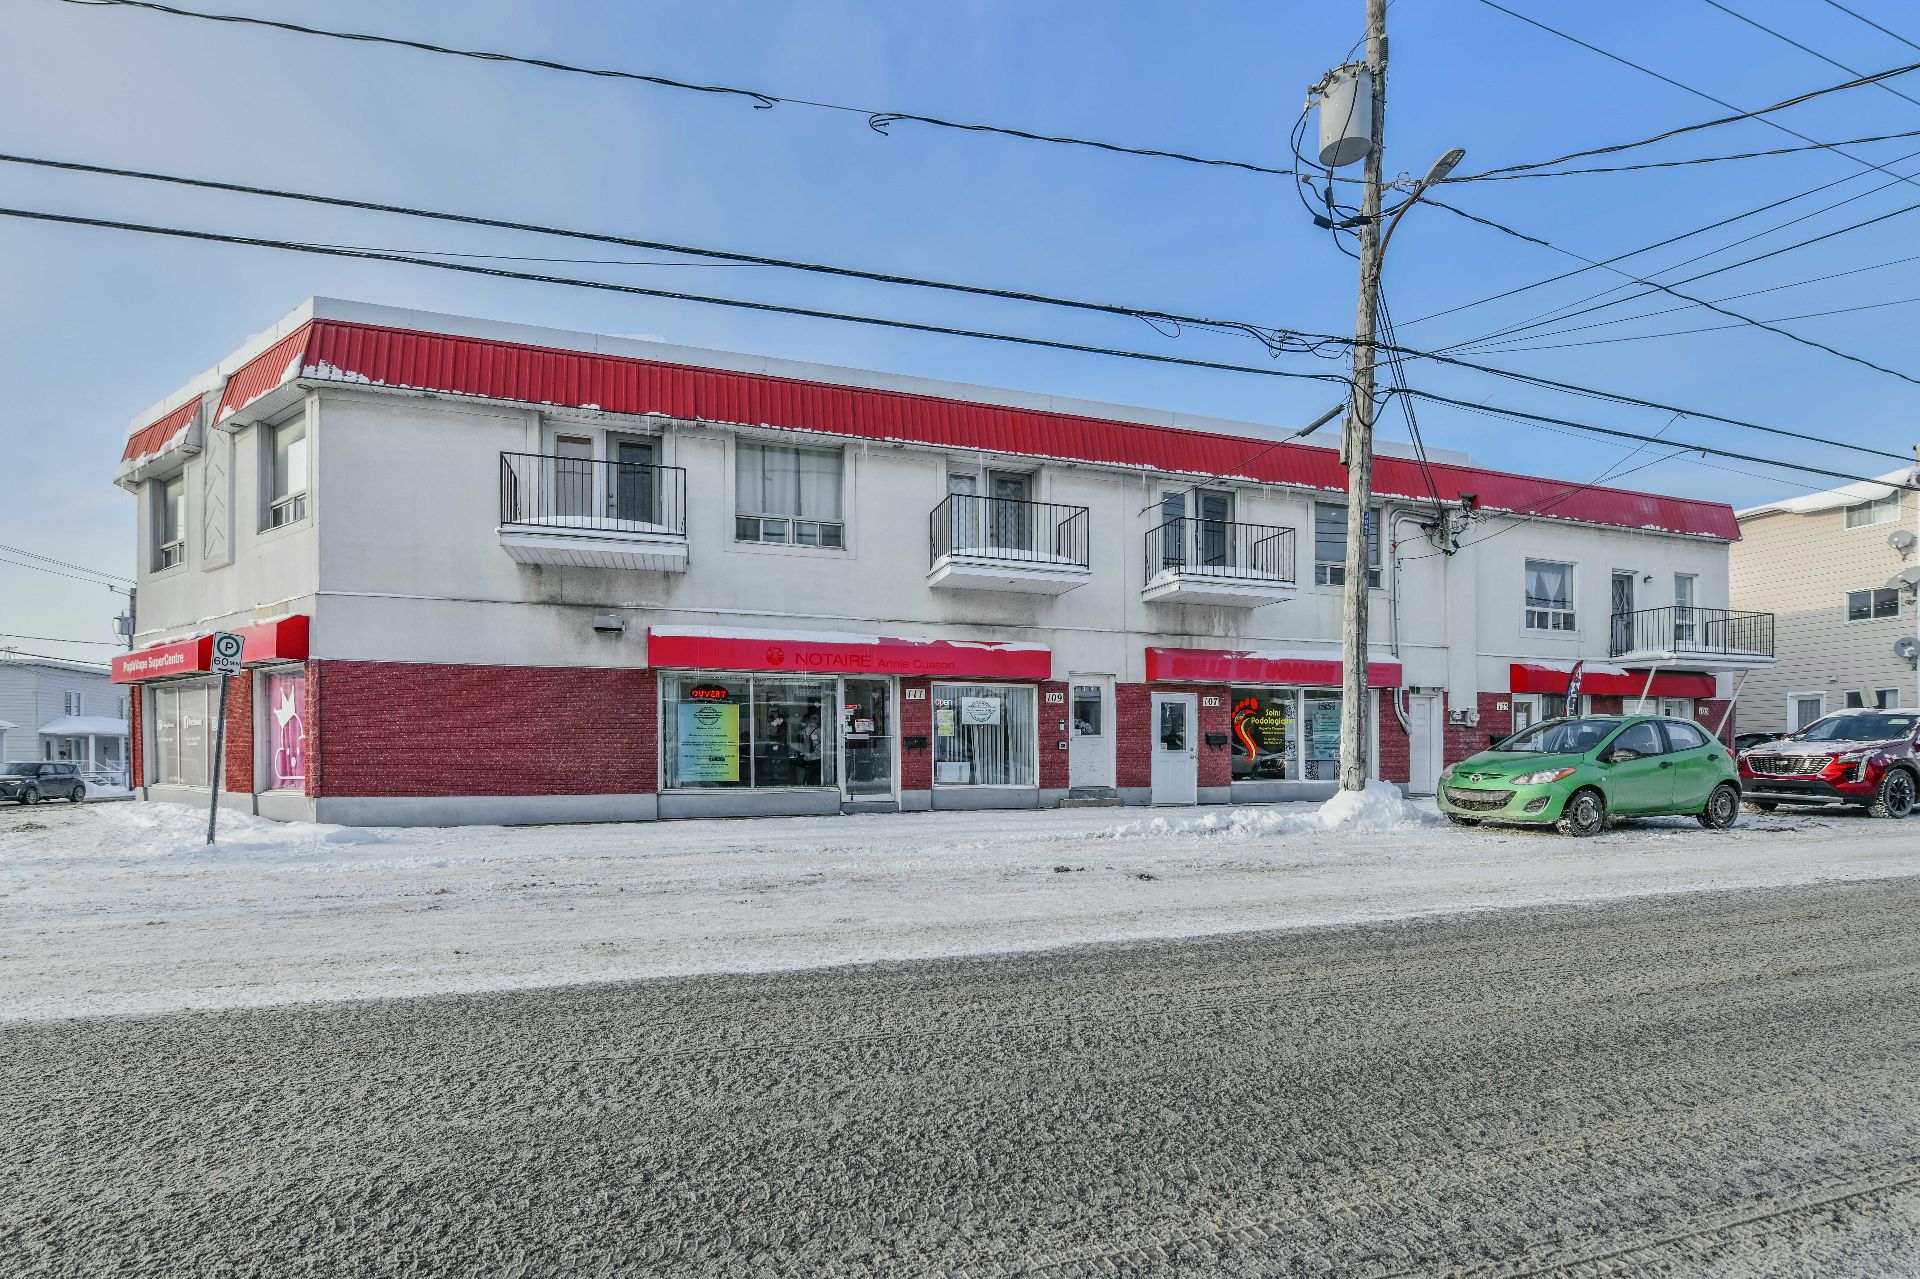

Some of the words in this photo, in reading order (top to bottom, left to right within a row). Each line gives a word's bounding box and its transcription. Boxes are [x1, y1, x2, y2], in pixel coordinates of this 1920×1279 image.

[225, 641, 234, 651] P
[148, 652, 184, 669] SuperCentre
[214, 657, 229, 666] 60
[795, 653, 871, 667] NOTAIRE
[878, 658, 909, 668] Annie
[913, 660, 955, 670] Cusson
[692, 690, 727, 698] OUVERT
[1047, 693, 1062, 702] 109
[1204, 697, 1218, 706] 107
